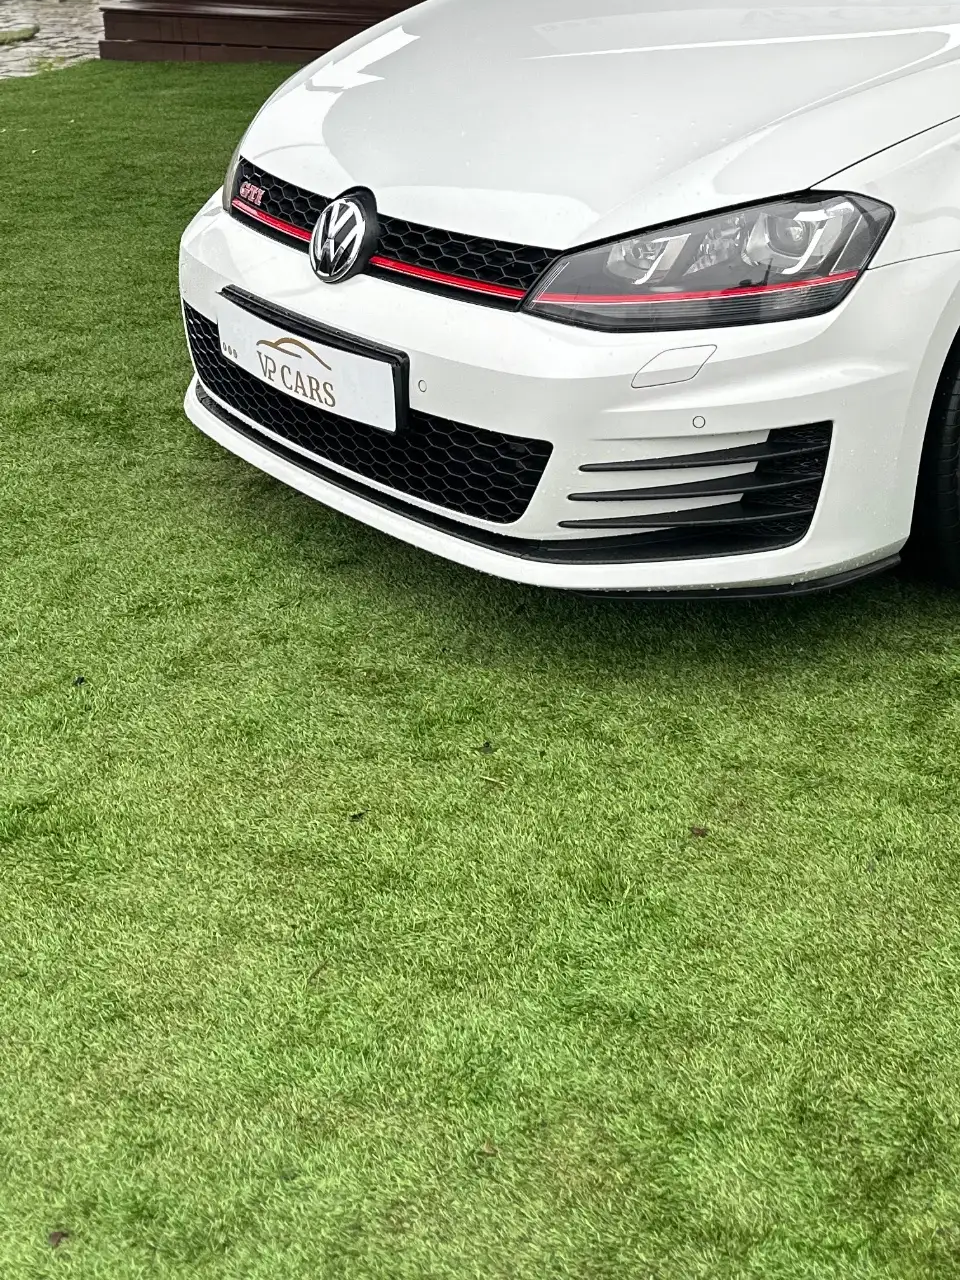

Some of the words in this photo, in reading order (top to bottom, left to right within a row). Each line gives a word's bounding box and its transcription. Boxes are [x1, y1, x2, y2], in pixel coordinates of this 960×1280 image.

[239, 180, 265, 206] GTI
[257, 350, 276, 382] VP
[280, 364, 336, 408] CARS
